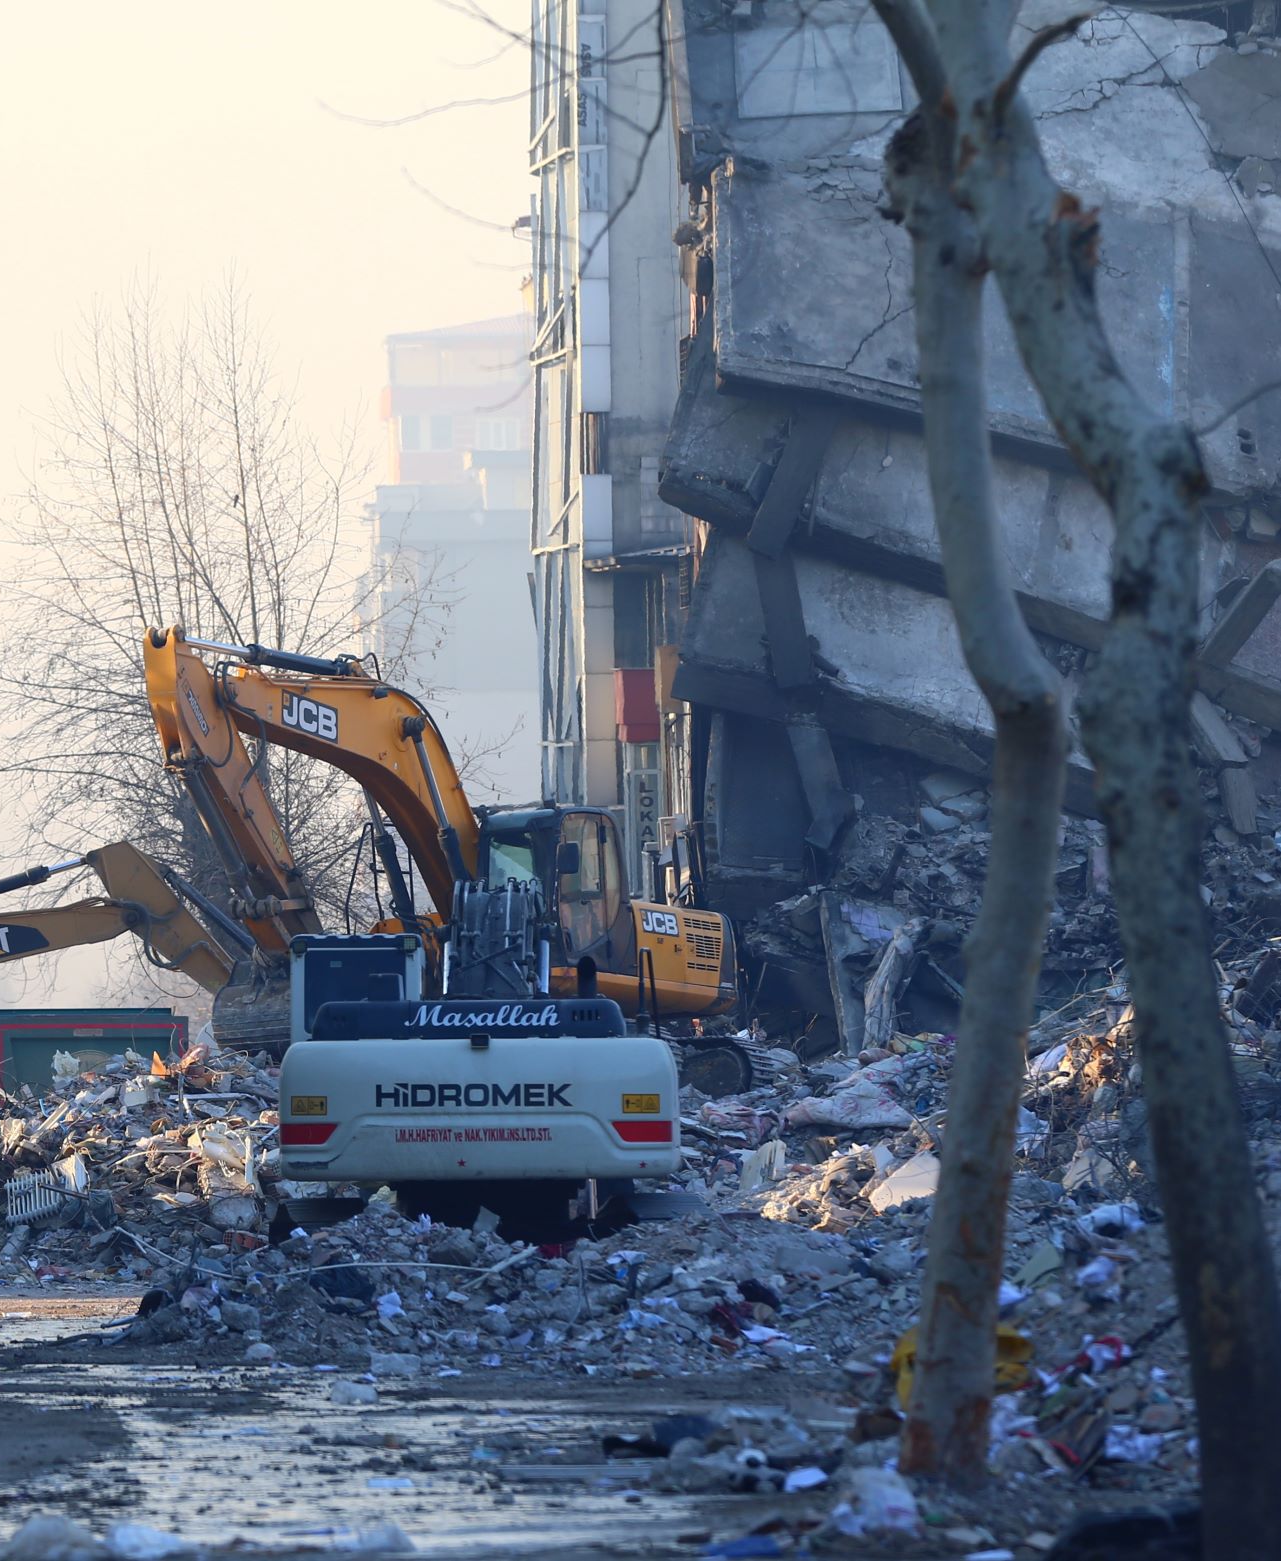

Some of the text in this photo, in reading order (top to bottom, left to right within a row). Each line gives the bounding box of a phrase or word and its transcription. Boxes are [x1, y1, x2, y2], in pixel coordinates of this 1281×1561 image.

[283, 696, 337, 740] JCB
[640, 781, 655, 843] LOKA
[643, 911, 679, 935] JCB
[453, 1131, 463, 1142] ve
